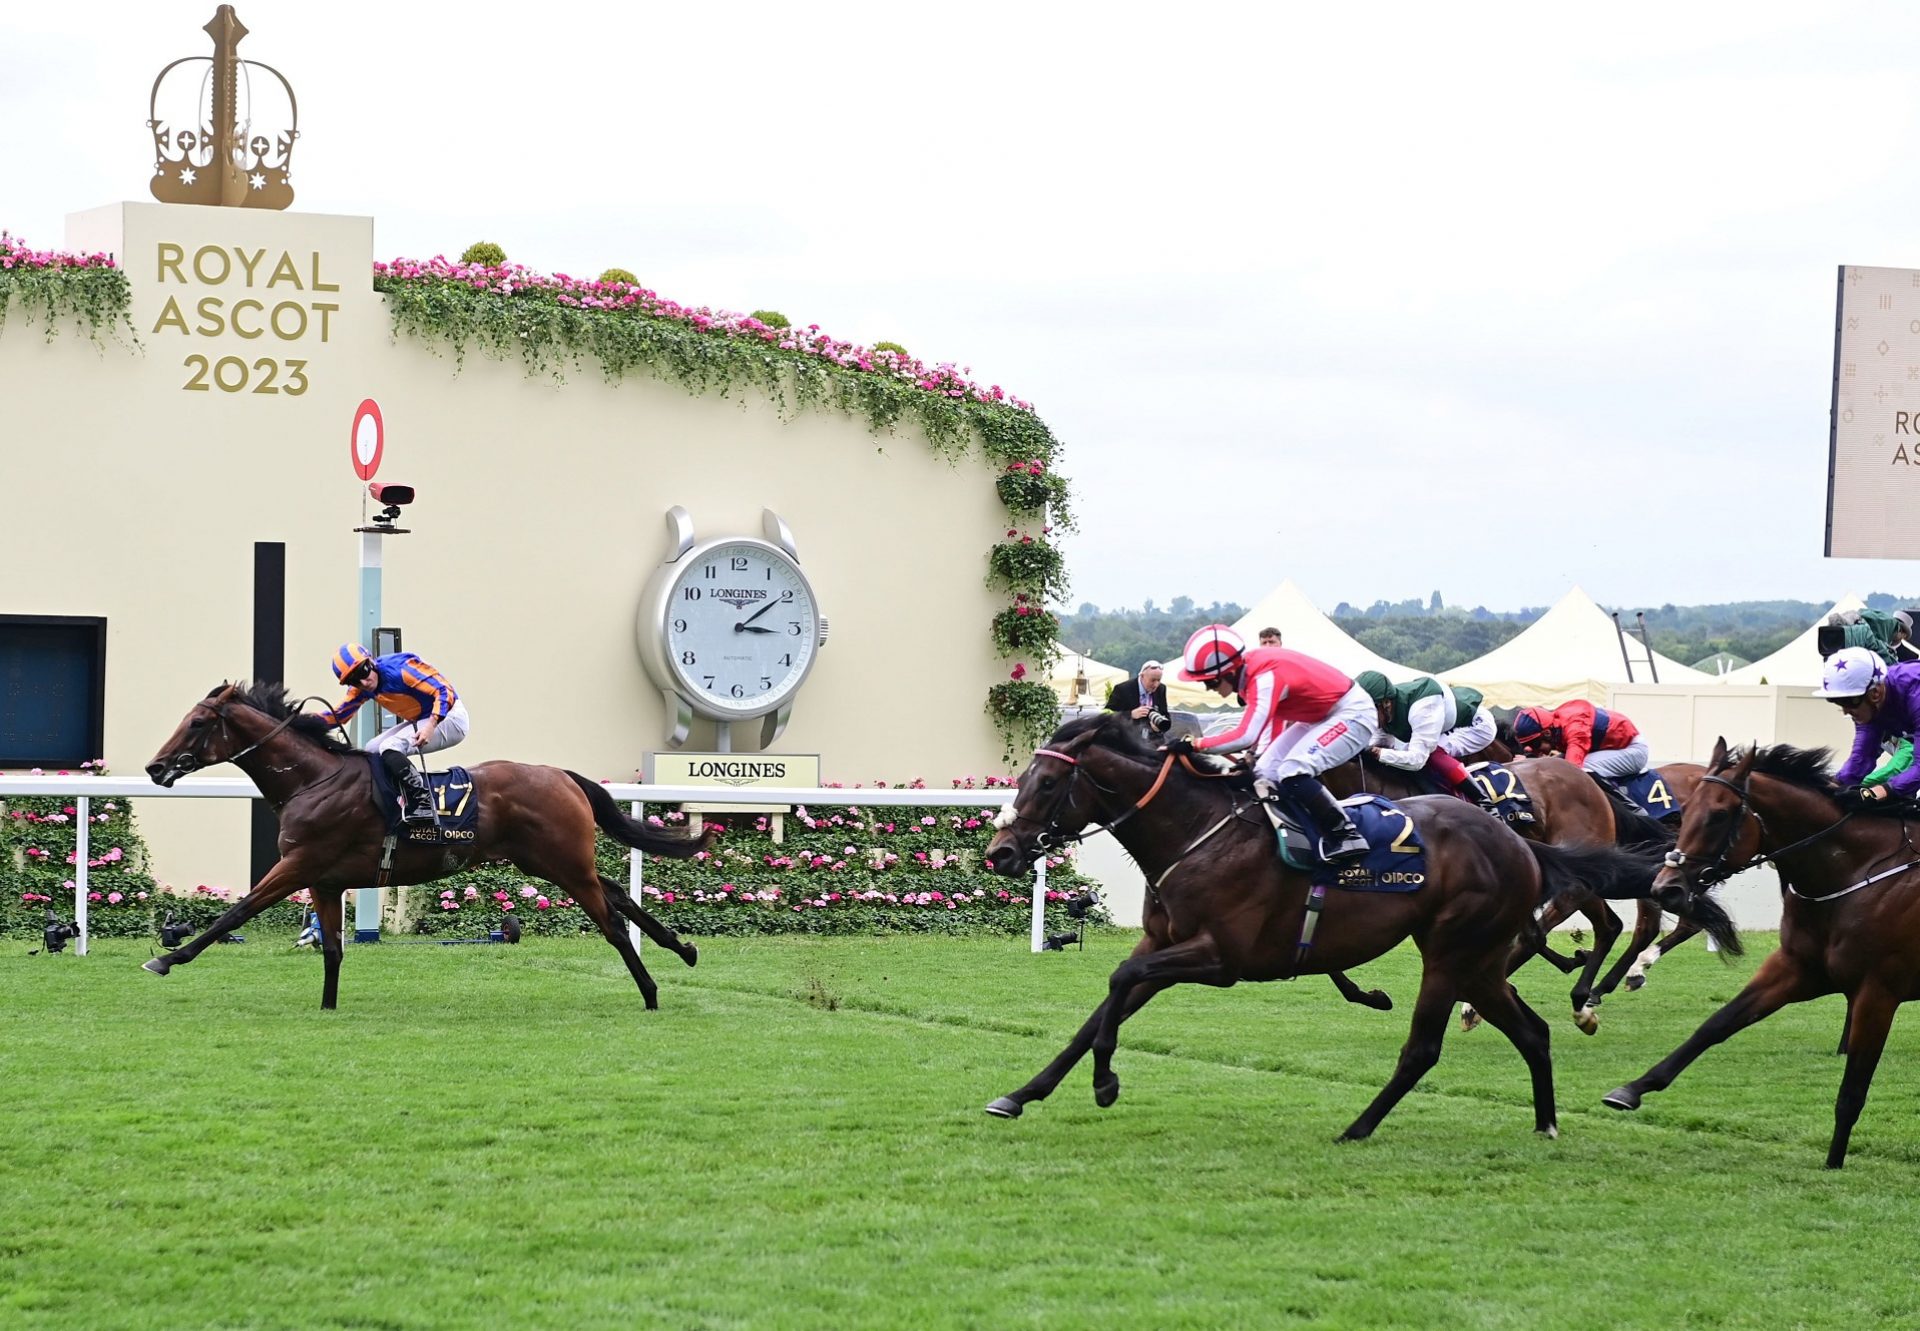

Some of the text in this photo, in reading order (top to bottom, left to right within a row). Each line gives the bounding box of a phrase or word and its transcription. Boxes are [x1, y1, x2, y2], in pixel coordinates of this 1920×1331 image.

[158, 243, 340, 292] ROYAL
[152, 295, 340, 343] ASCOT
[182, 354, 309, 396] 2023
[731, 557, 748, 571] 12
[705, 565, 716, 579] 11
[766, 568, 771, 581] 1
[684, 586, 701, 601] 10
[710, 588, 767, 599] LONGINES
[781, 589, 793, 603] 2
[674, 619, 687, 633] 9
[788, 621, 801, 636] 3
[682, 651, 696, 665] 8
[778, 653, 792, 667] 4
[703, 675, 715, 689] 7
[760, 676, 772, 690] 5
[731, 684, 744, 698] 6
[688, 762, 786, 778] LONGINES
[434, 782, 473, 817] 17
[1647, 779, 1673, 809] 4
[1381, 809, 1420, 853] 2
